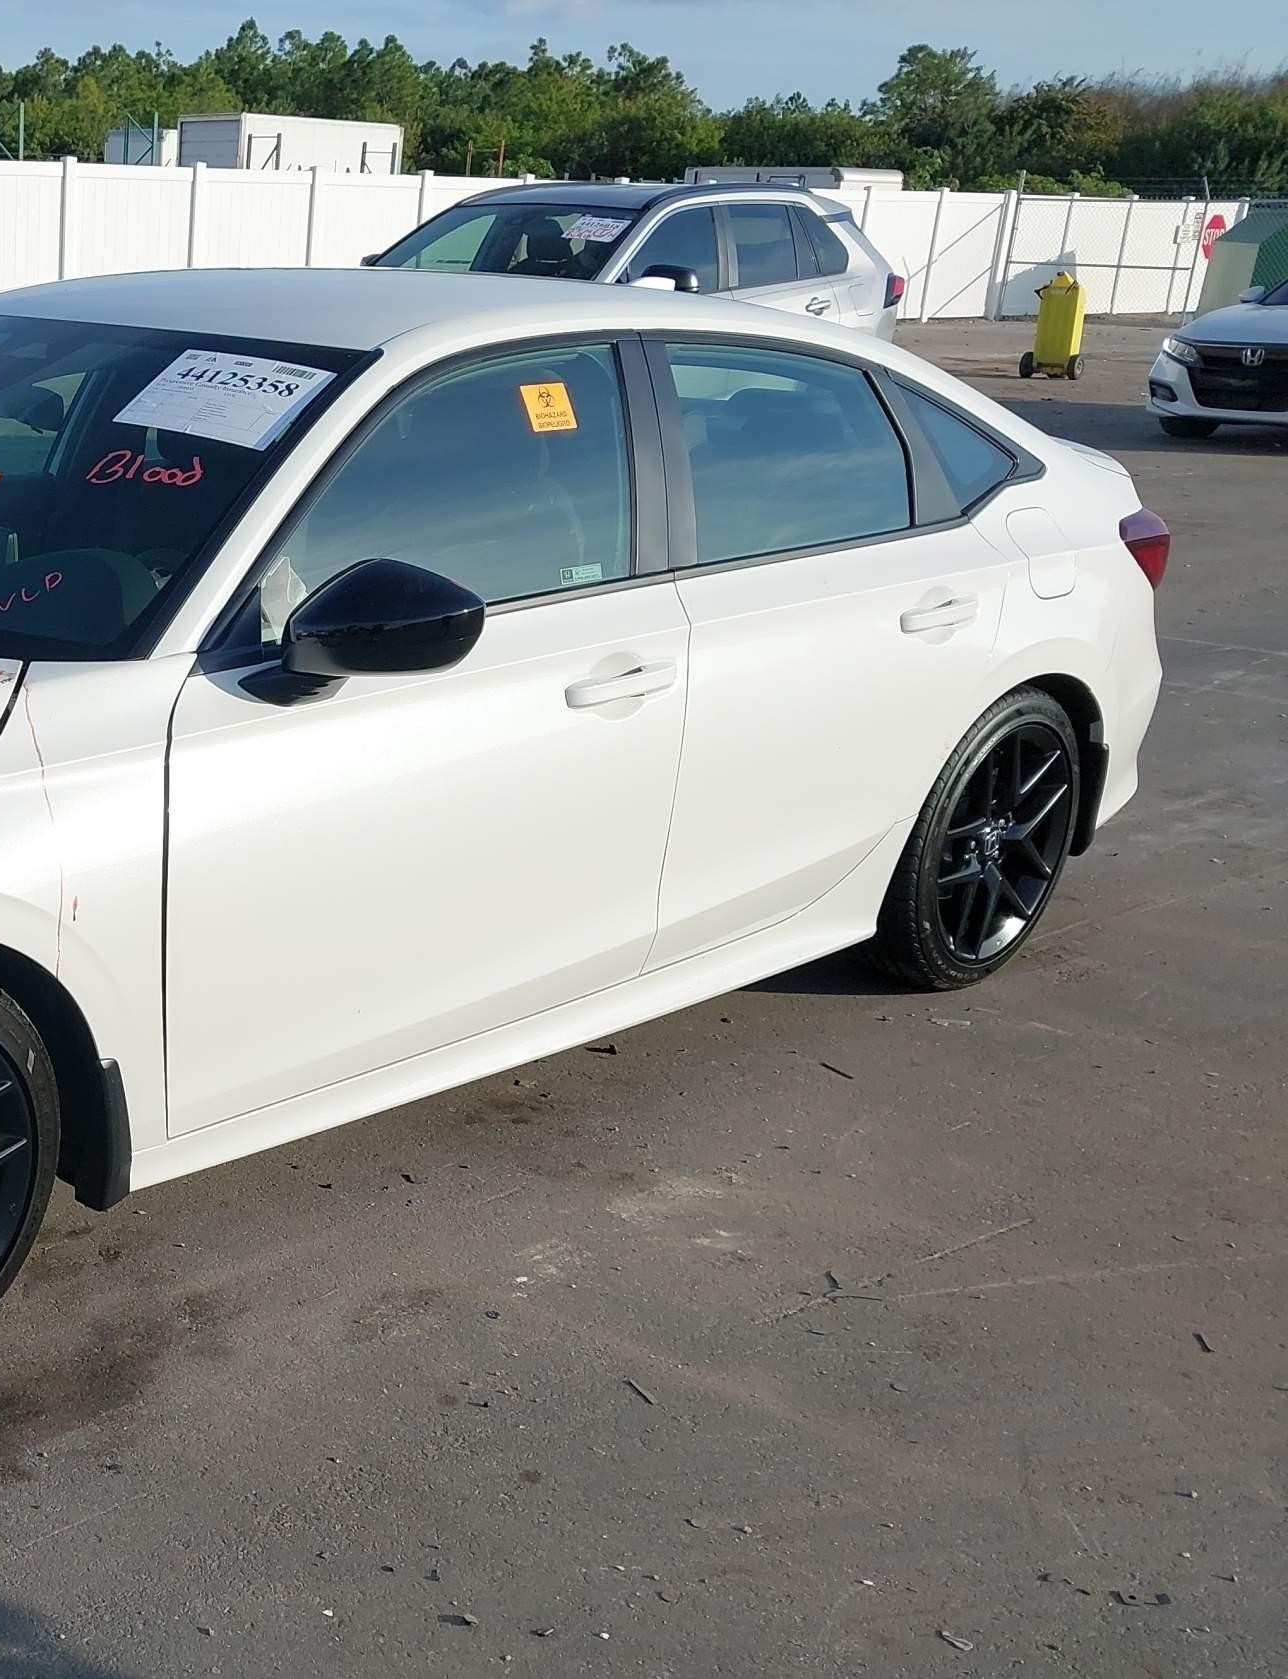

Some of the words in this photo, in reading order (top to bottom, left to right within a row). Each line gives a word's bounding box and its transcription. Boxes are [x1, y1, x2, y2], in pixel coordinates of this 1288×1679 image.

[177, 366, 300, 397] 44125358
[535, 411, 568, 420] BIOHAZARD
[87, 449, 203, 487] Blood
